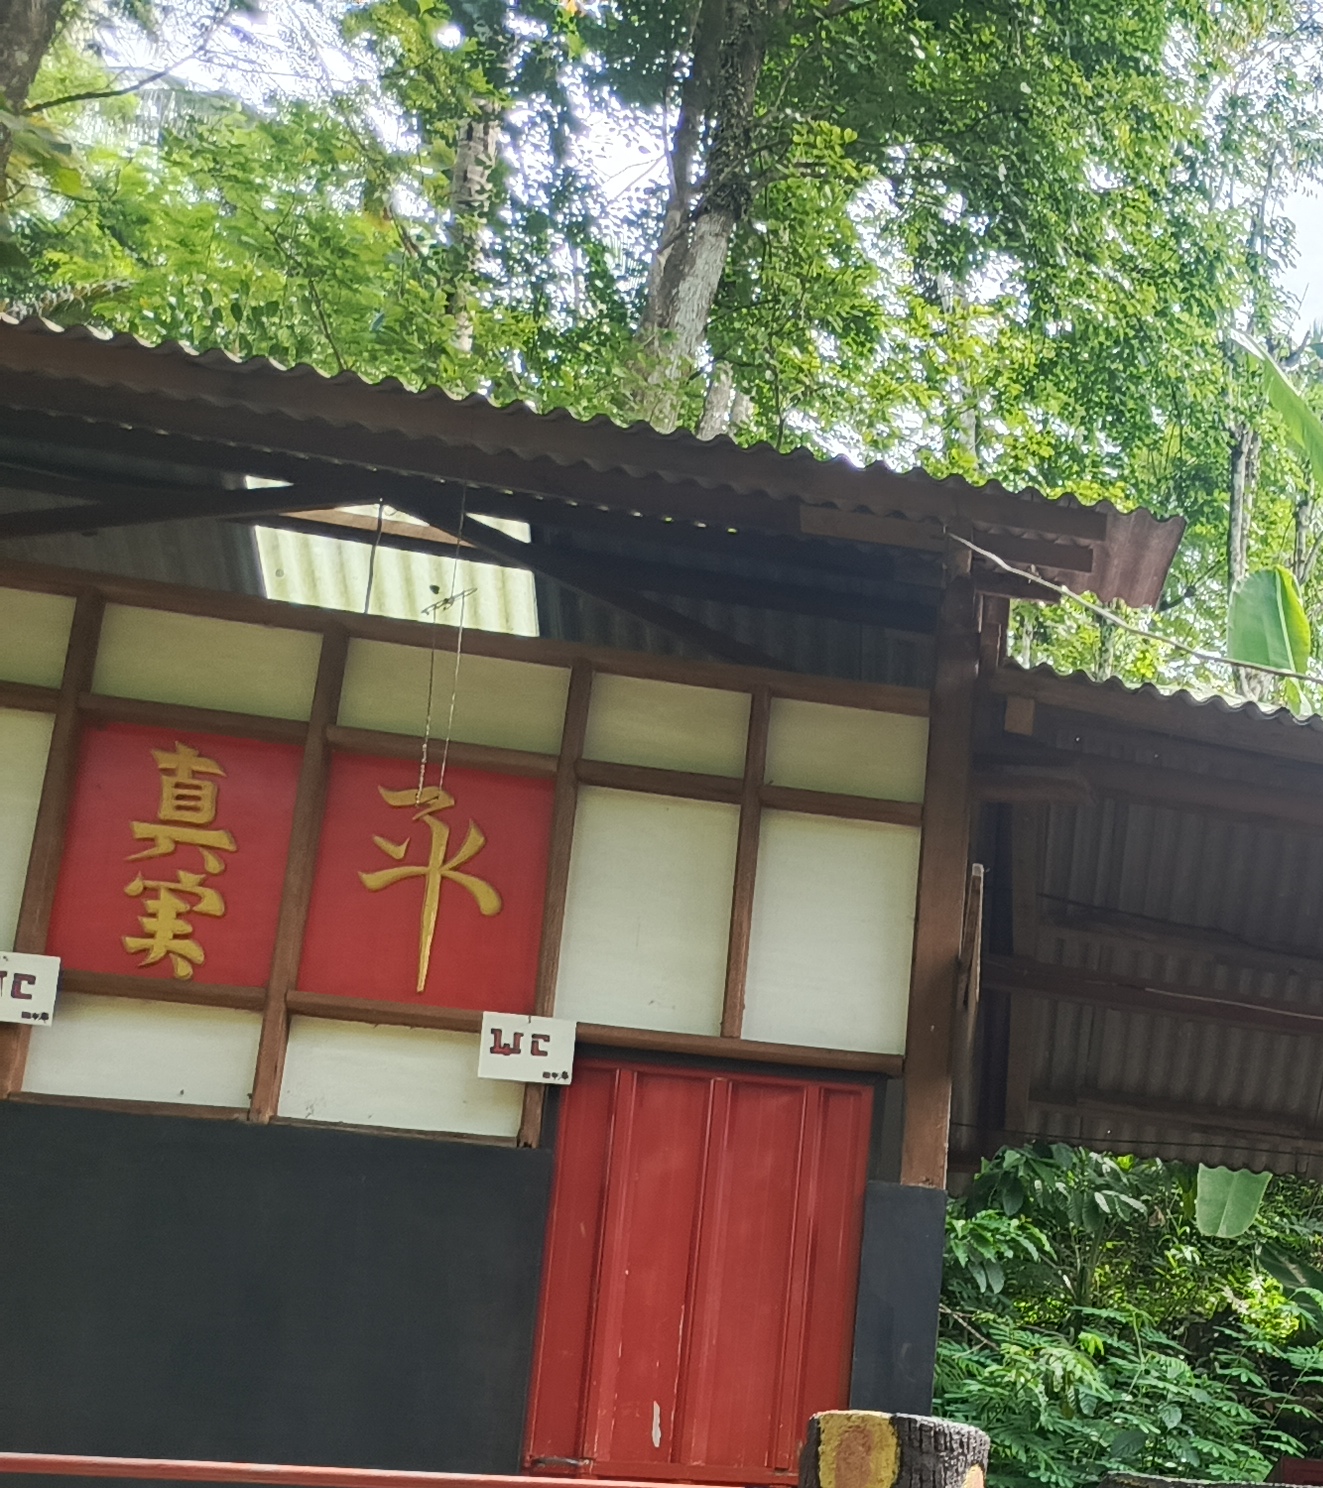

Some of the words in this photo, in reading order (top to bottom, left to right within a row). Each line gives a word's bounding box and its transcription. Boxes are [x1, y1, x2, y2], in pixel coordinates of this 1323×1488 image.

[121, 740, 238, 980] 真実
[0, 970, 37, 1000] C
[489, 1027, 551, 1057] WC
